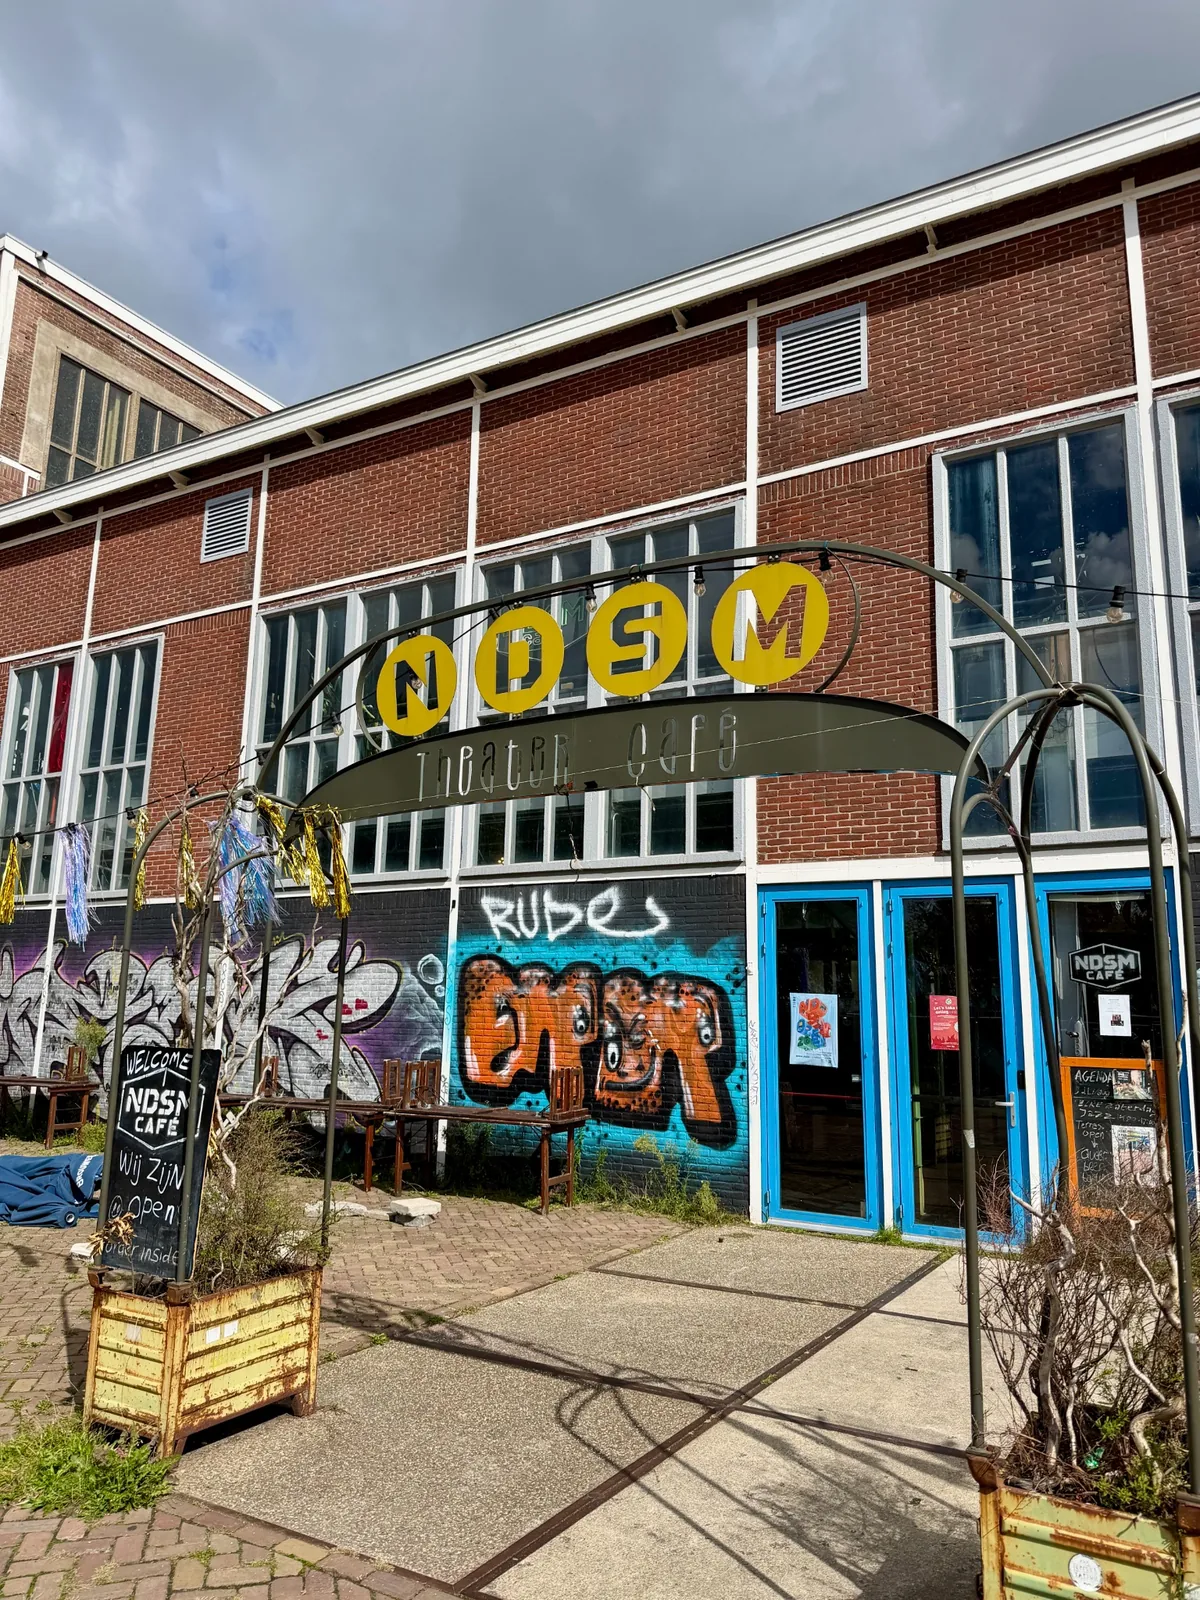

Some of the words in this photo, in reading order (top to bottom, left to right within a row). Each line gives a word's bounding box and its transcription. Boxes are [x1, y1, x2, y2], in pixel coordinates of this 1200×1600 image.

[394, 584, 808, 721] NDSM
[1075, 954, 1136, 971] NDSM
[1086, 969, 1124, 980] CAFÉ
[126, 1049, 194, 1076] WELCOME
[134, 1116, 181, 1137] CAFÉ
